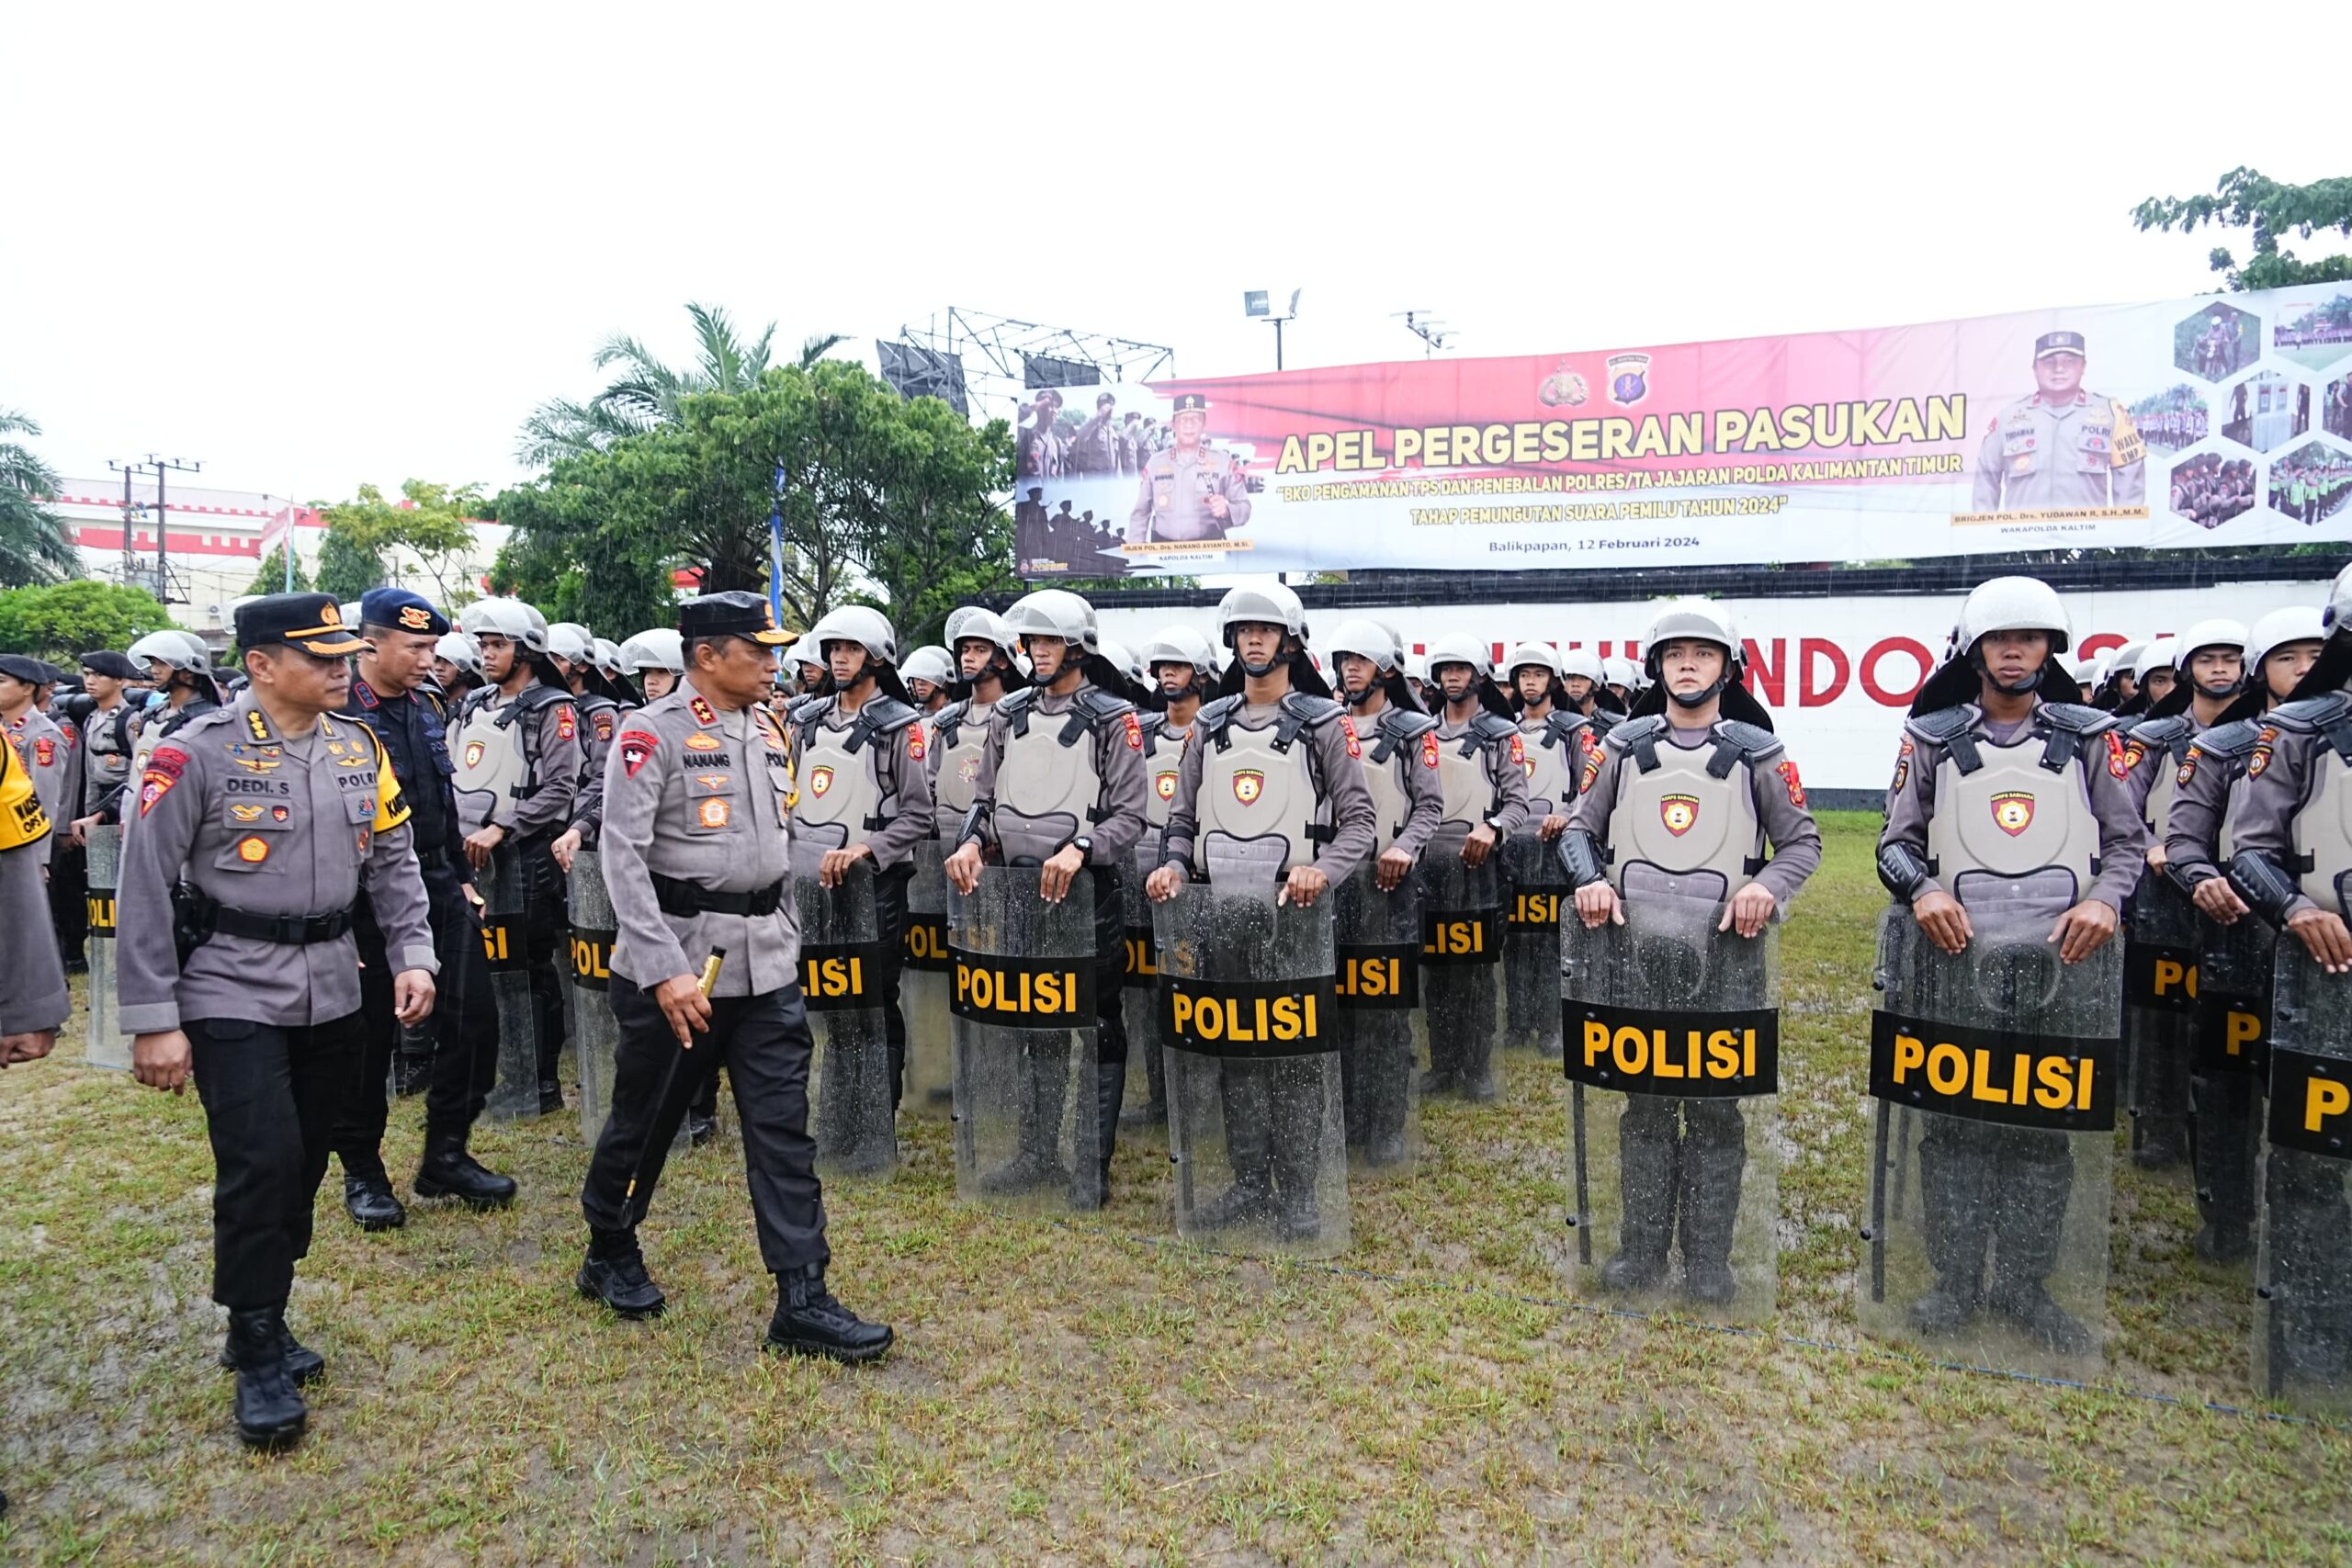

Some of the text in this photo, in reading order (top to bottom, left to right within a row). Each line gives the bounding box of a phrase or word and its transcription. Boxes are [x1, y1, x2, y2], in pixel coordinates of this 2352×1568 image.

[1275, 393, 1967, 474] APEL PERGESERAN PASUKAN
[1313, 479, 1410, 502] PENGAMANAN
[1411, 479, 1440, 497] TPS
[1441, 477, 1472, 496] DAN
[1473, 475, 1563, 495] PENEBALAN
[1655, 467, 1732, 489] JAJARAN
[1734, 463, 1789, 484] POLDA
[1790, 457, 1903, 482] KALIMANTAN
[1905, 454, 1963, 476] TIMUR
[1409, 496, 1788, 525] TAHAP PEMUNGUTAN SUARA PEMILU TAHUN 2024"
[2000, 525, 2058, 534] WAKAPOLDA
[1488, 537, 1700, 553] Balikpapan, 12 Februari 2024
[684, 753, 730, 768] NANANG
[227, 779, 289, 795] DEDI. S
[338, 773, 377, 788] POLRI
[1509, 895, 1557, 923] ISI
[957, 964, 1076, 1013] POLISI
[1170, 992, 1317, 1042] POLISI
[1583, 1020, 1756, 1079] POLISI
[1893, 1034, 2094, 1111] POLISI
